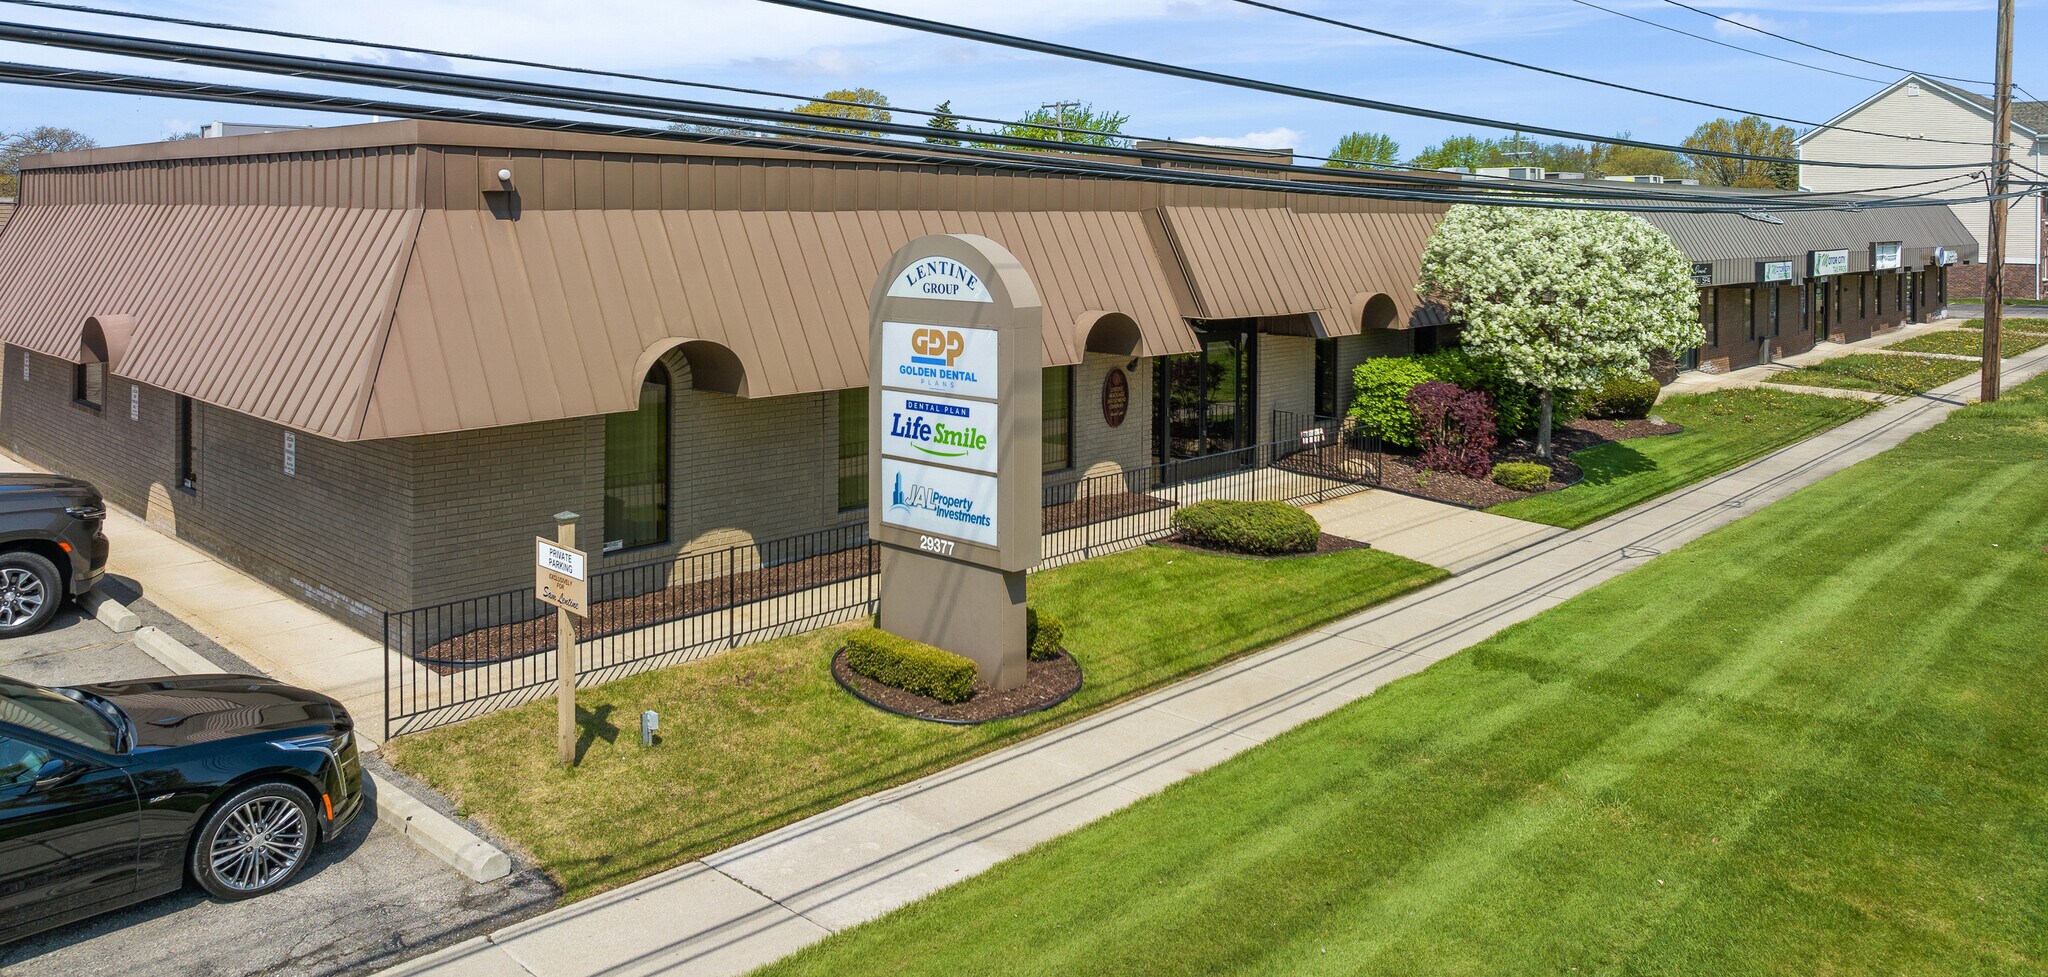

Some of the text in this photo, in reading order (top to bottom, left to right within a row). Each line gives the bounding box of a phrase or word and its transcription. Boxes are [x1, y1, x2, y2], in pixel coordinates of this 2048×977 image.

[906, 261, 978, 291] LENTINE
[922, 282, 959, 295] GROUP
[911, 328, 965, 367] GDP
[899, 364, 978, 383] GOLDEN DENTAL
[920, 378, 955, 389] PLANS
[908, 401, 967, 416] DENTAL PLAN
[890, 412, 987, 451] Life Smile
[905, 484, 973, 512] JAL Property
[936, 505, 991, 527] Investments
[920, 534, 955, 556] 29377
[549, 548, 572, 563] PRIVATE
[548, 558, 573, 573] PARKING
[558, 592, 579, 609] Lentine
